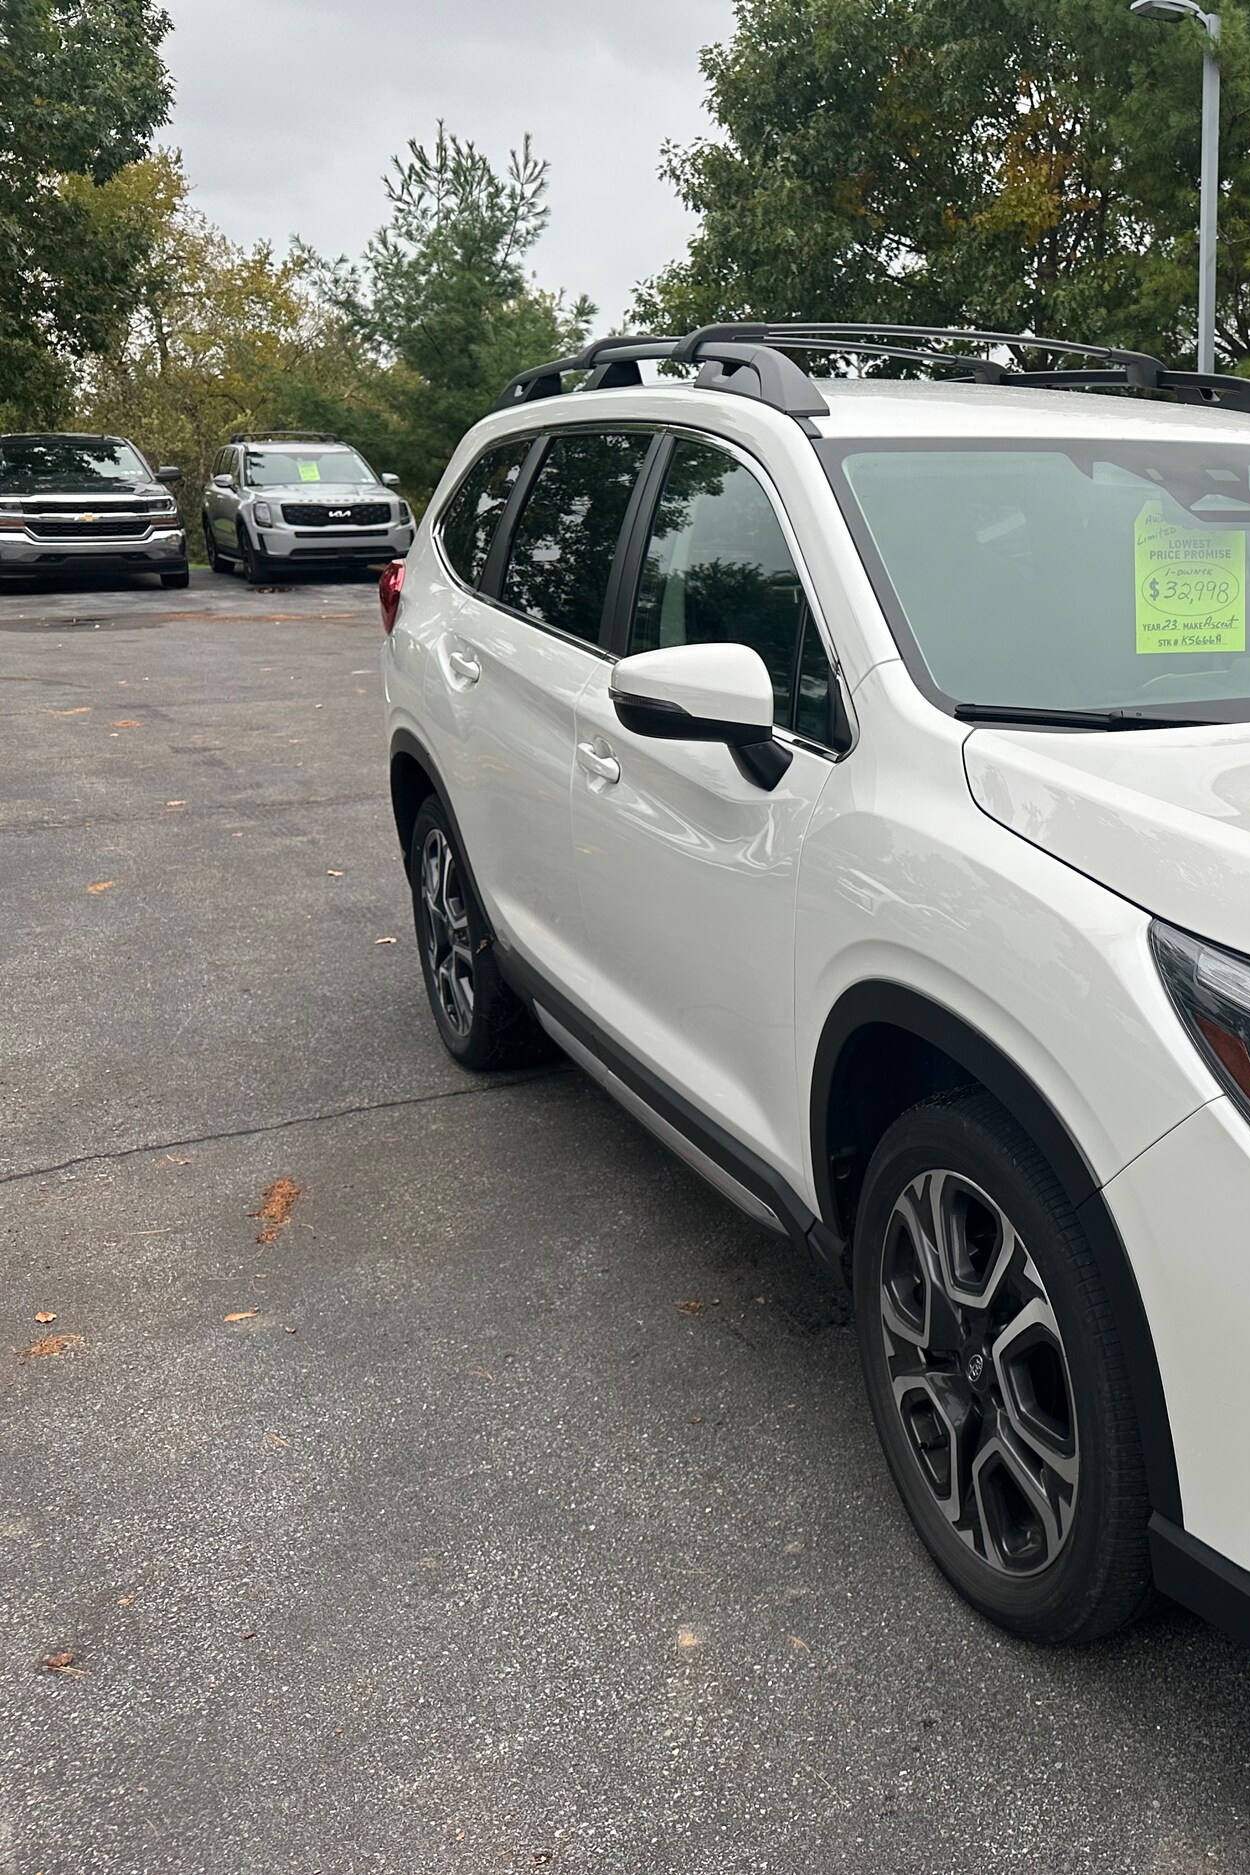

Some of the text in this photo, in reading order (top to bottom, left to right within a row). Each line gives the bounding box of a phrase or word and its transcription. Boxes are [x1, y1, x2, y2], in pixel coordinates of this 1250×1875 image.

[1169, 539, 1212, 549] LOWEST
[1149, 549, 1232, 560] PRICE PROMISE
[1142, 623, 1160, 631] YEAR
[1161, 619, 1178, 631] 23
[1183, 622, 1203, 630] MAKE
[1158, 638, 1172, 646] STK
